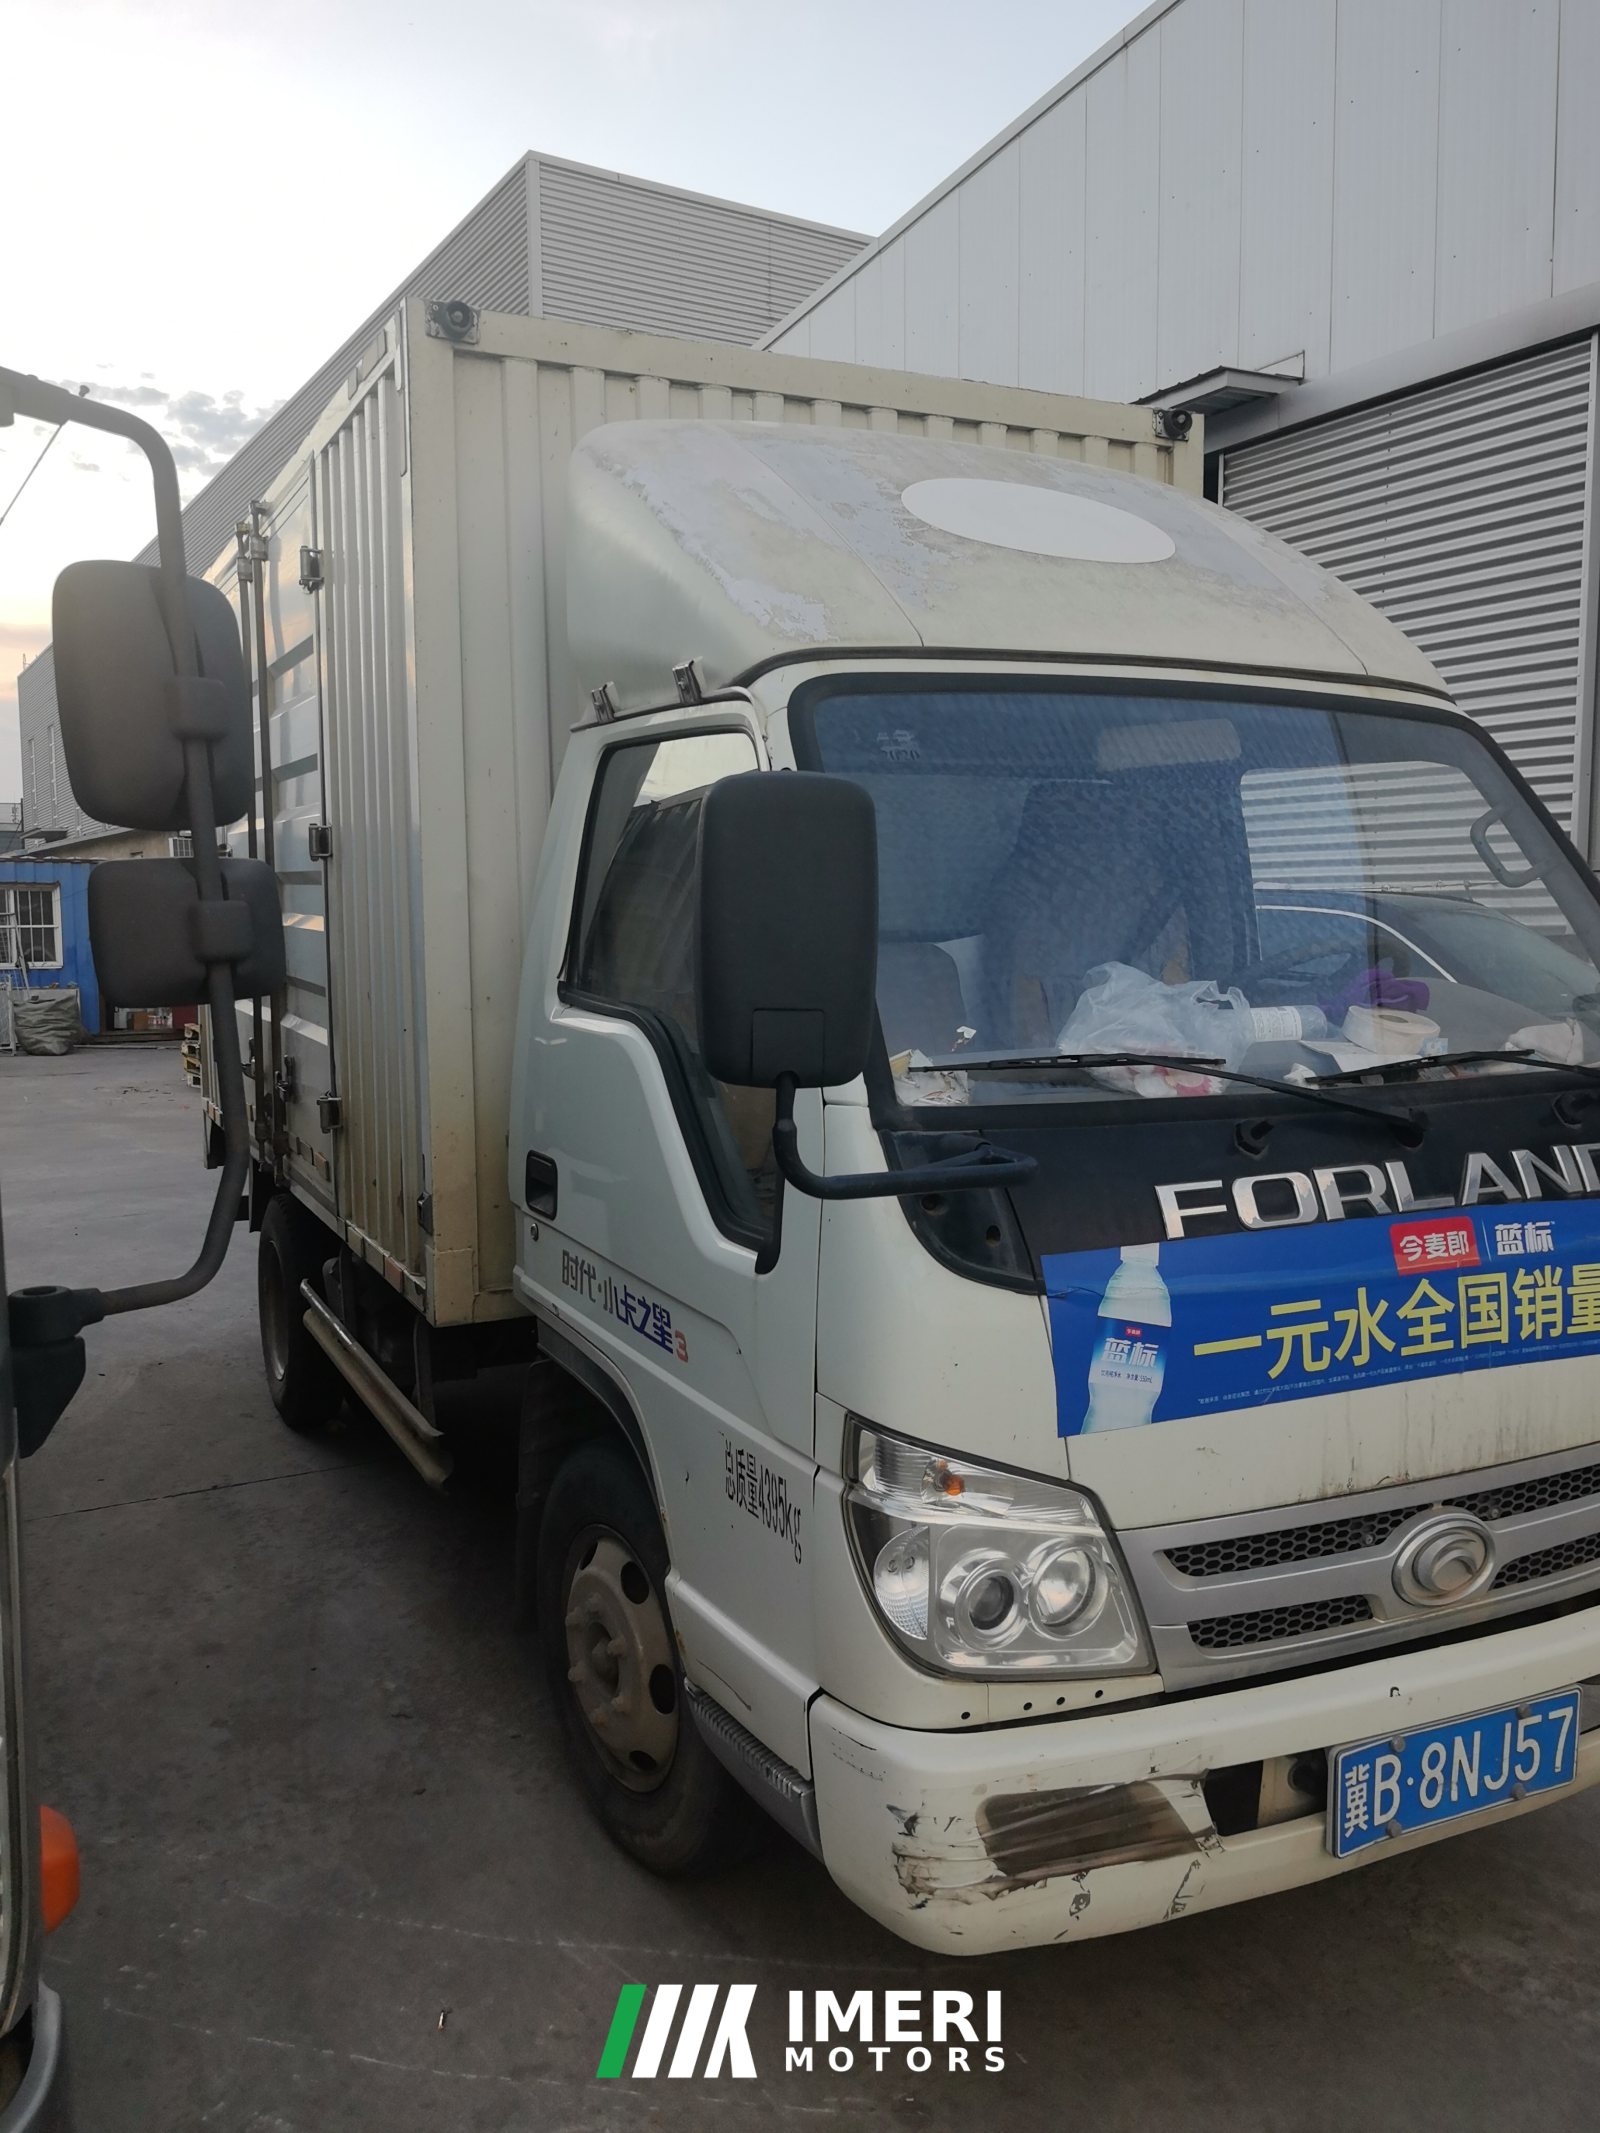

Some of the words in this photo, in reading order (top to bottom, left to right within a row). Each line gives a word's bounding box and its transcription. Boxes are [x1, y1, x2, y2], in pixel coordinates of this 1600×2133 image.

[1400, 1230, 1469, 1262] 今麦郎
[1495, 1221, 1554, 1256] 蓝标
[1193, 1263, 1600, 1380] 一元水全国销量
[1101, 1337, 1159, 1368] 蓝标
[725, 1439, 801, 1564] 总质量4395kg
